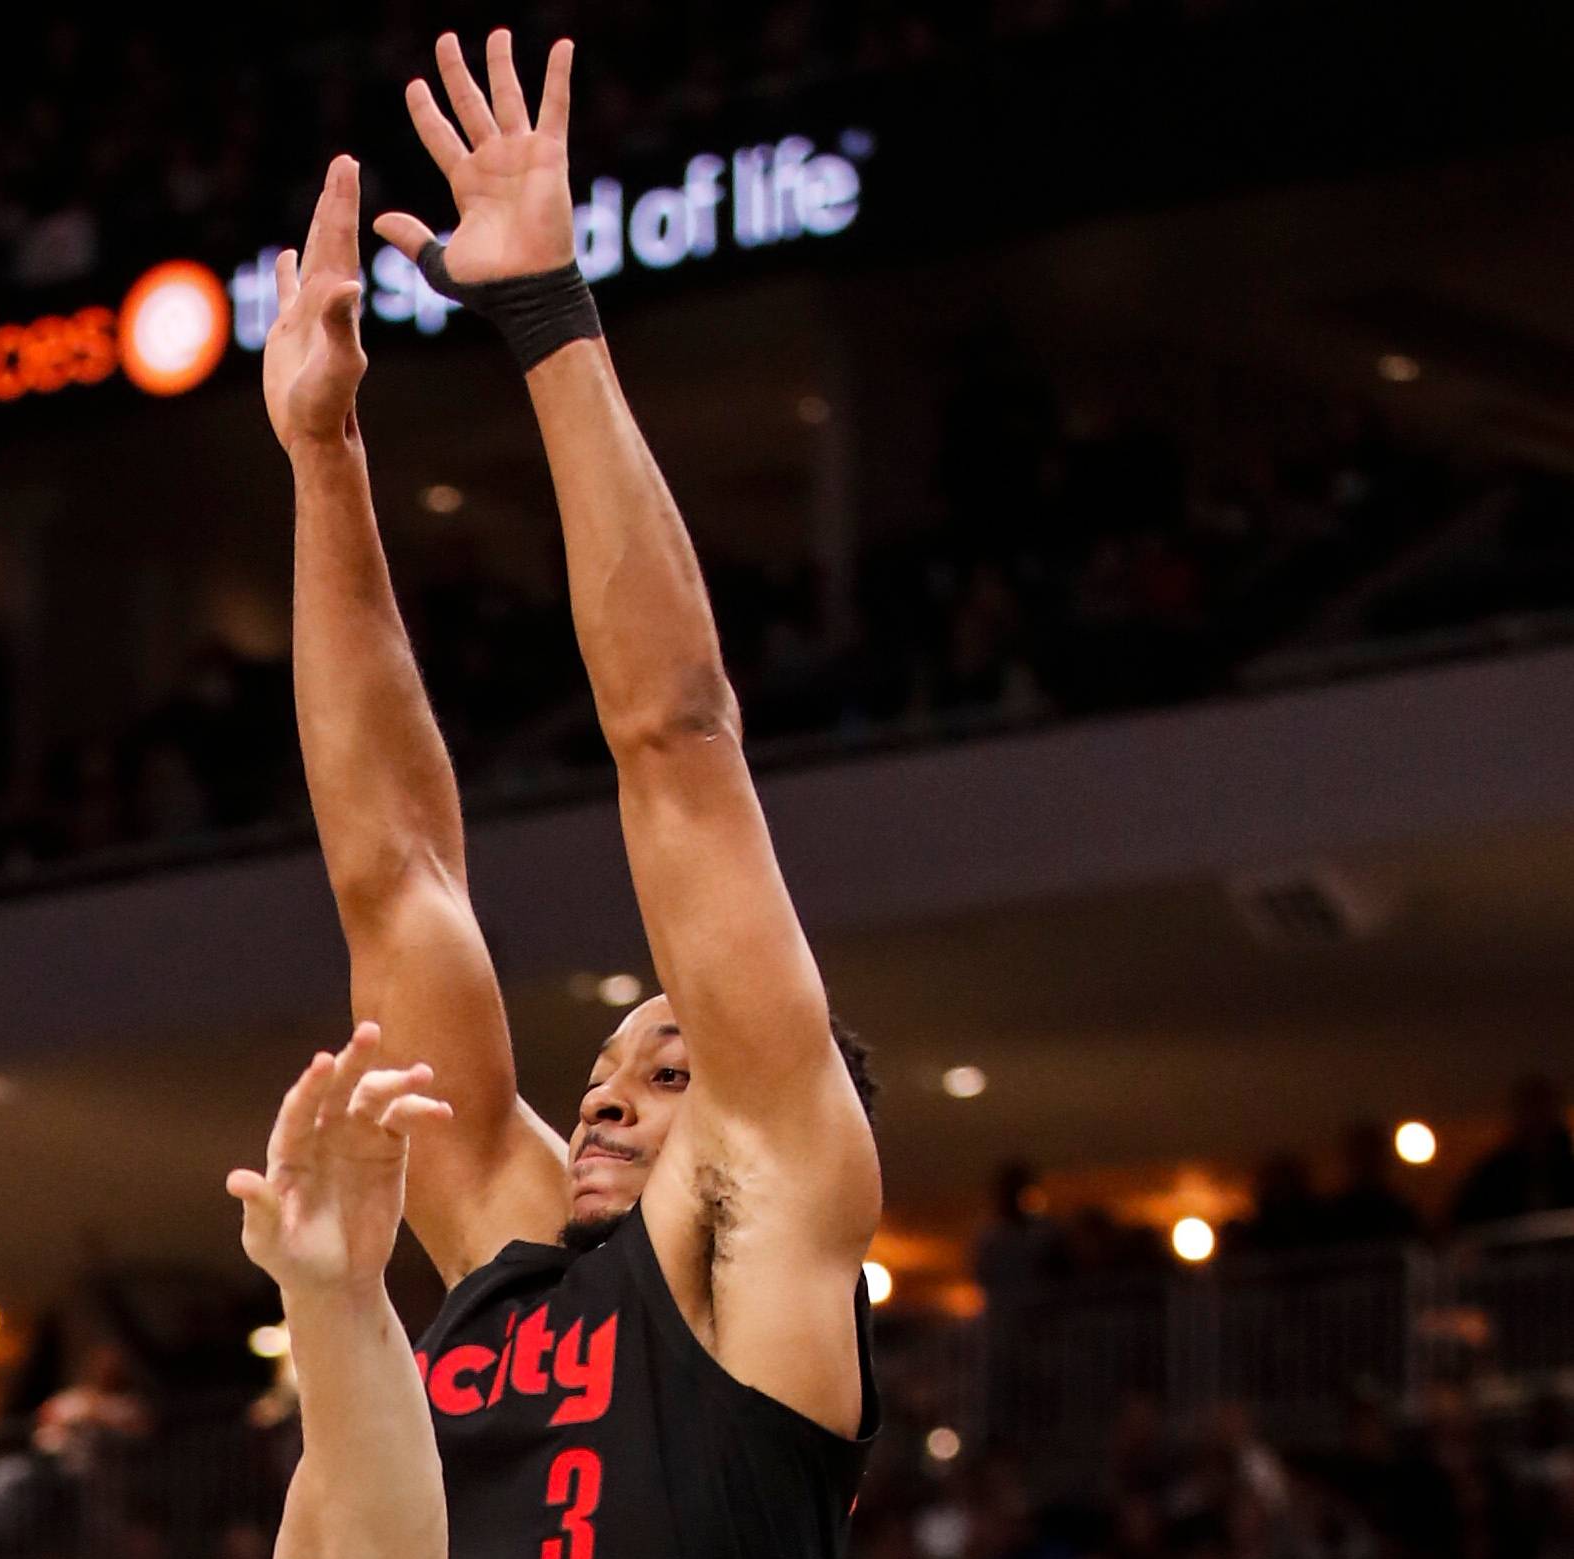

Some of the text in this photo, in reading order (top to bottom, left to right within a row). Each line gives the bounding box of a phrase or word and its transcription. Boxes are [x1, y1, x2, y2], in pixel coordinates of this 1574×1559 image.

[629, 154, 725, 269] of
[732, 135, 860, 247] life
[416, 1302, 619, 1427] city
